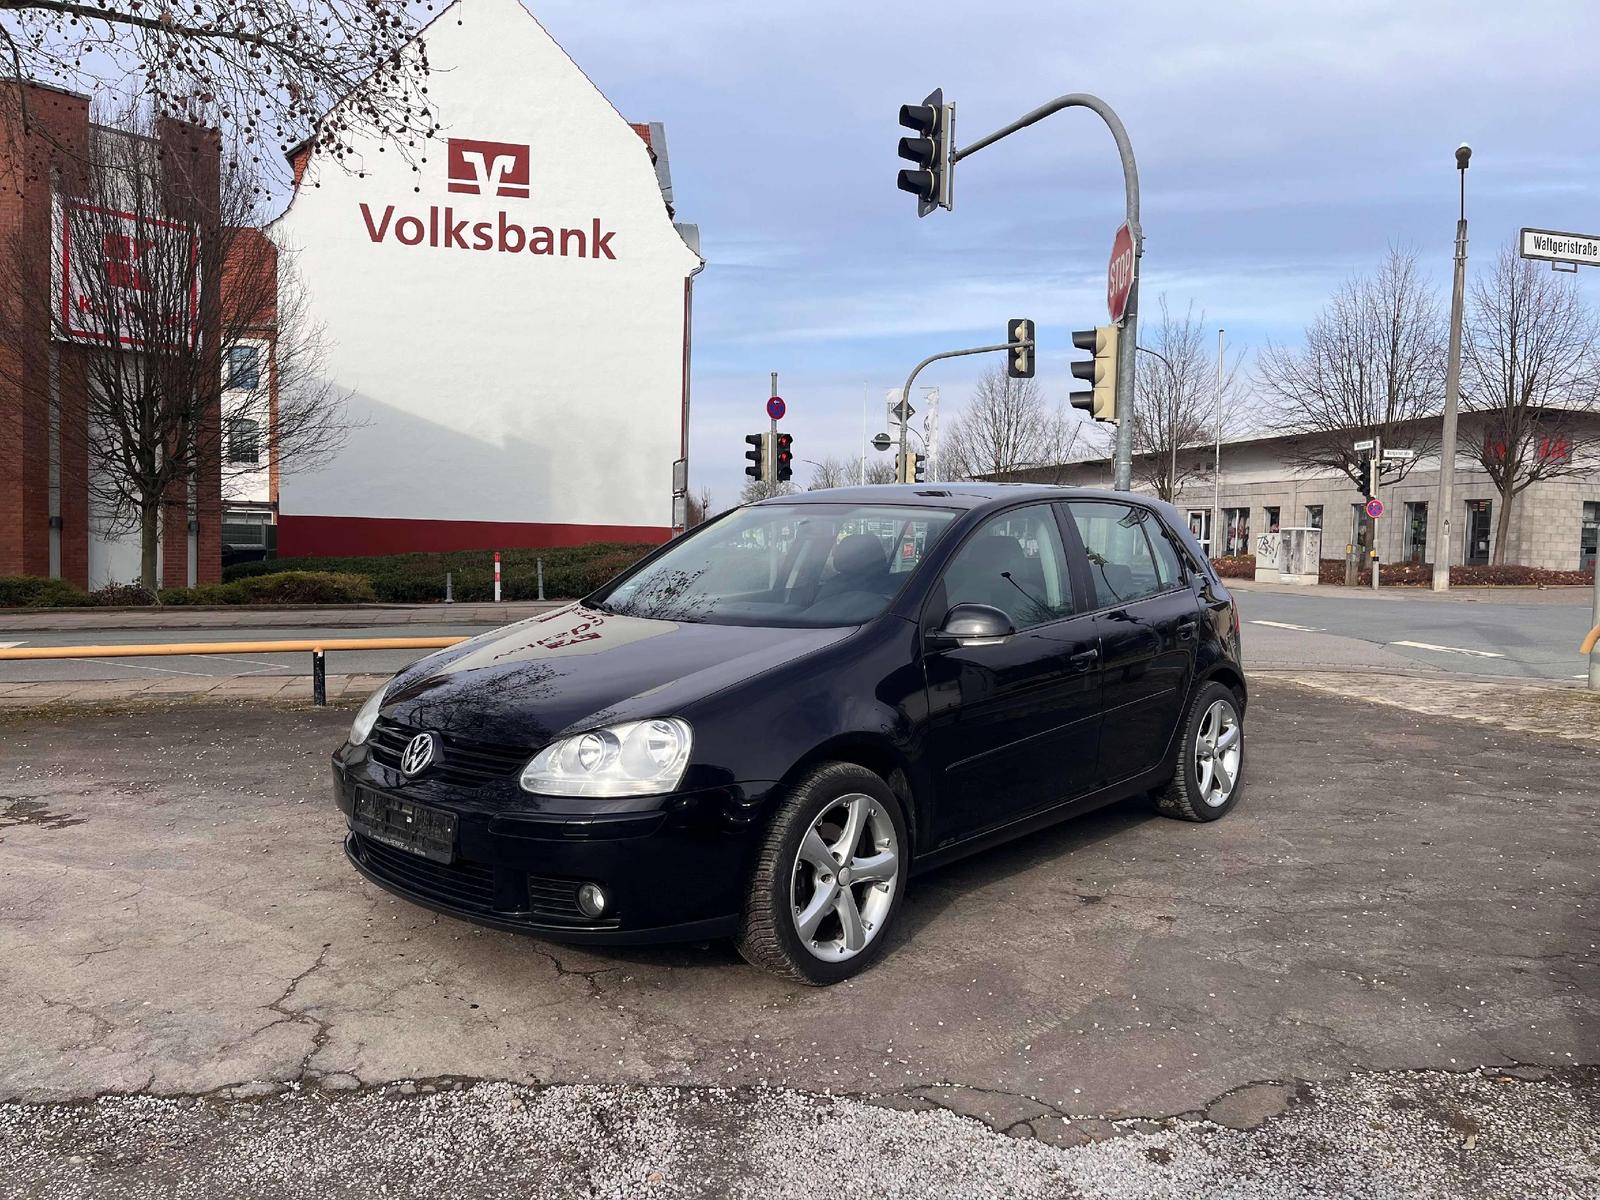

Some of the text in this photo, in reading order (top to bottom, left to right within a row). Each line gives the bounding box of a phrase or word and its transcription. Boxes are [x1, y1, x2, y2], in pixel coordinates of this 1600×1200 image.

[359, 203, 617, 260] Volksbank
[1533, 235, 1598, 256] Waltgeristraße
[1109, 248, 1131, 298] STOP
